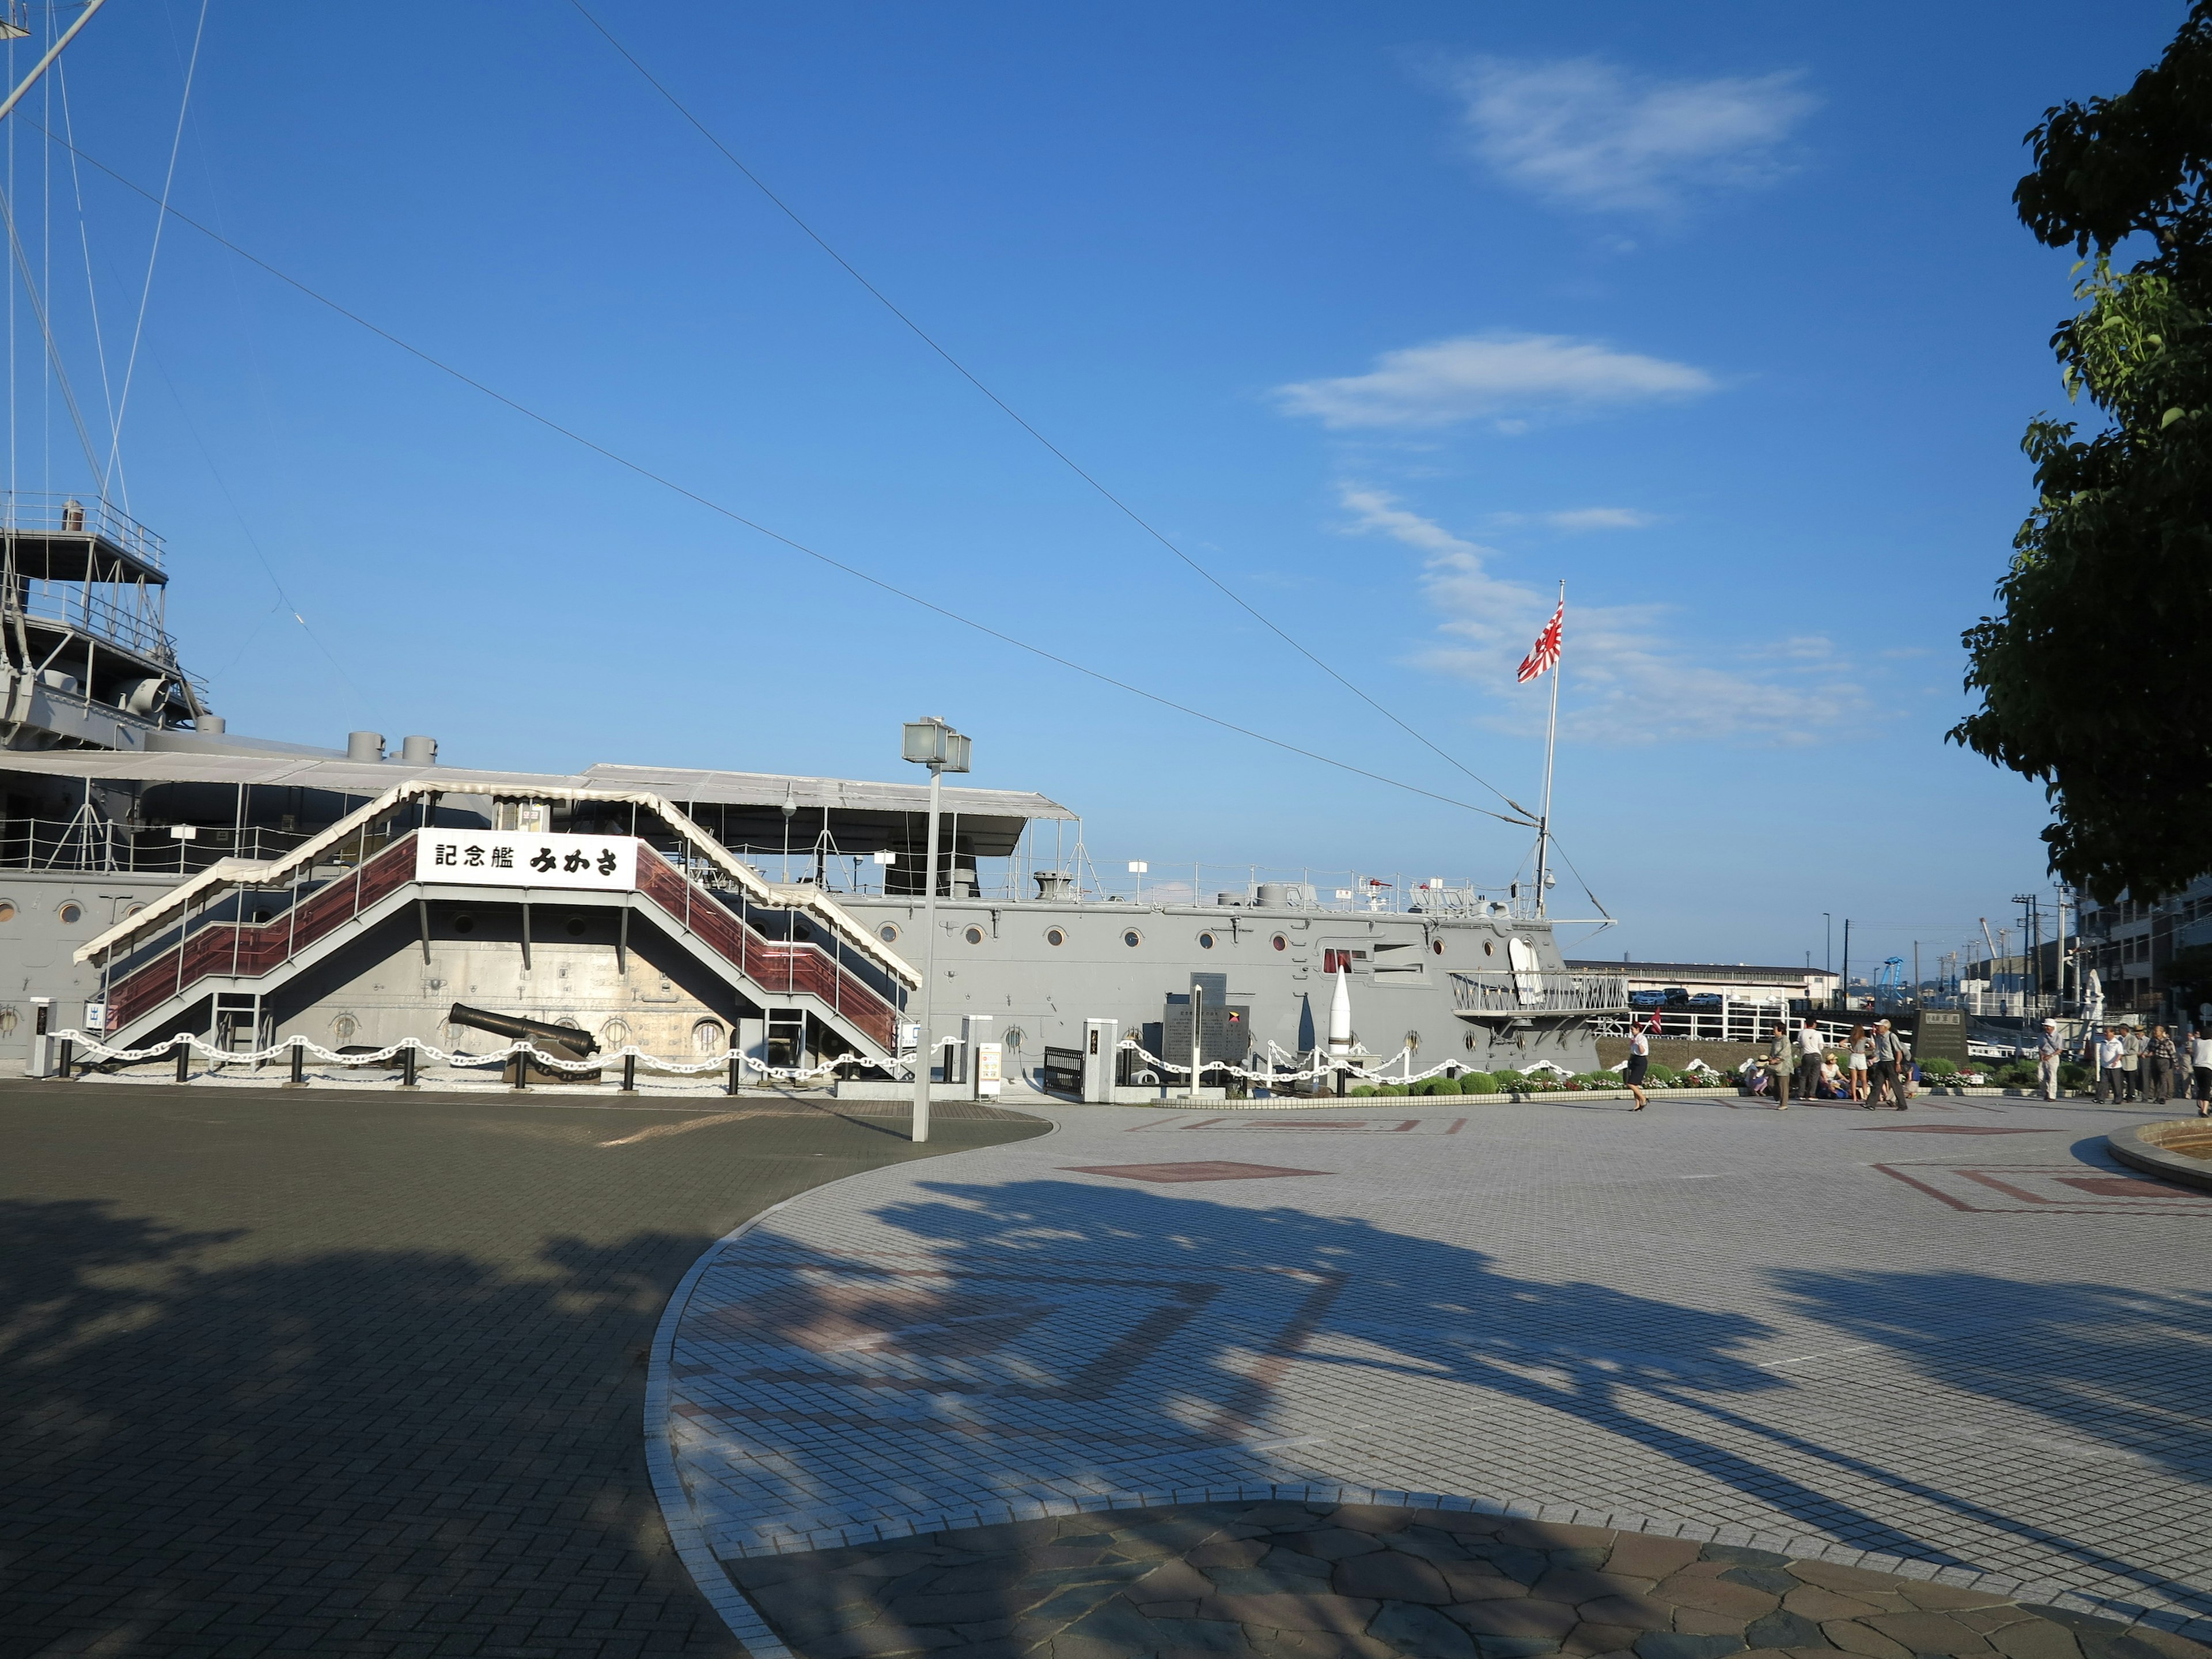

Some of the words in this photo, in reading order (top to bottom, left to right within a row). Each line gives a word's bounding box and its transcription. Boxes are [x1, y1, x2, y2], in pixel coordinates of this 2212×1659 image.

[435, 844, 514, 868] 記念艦
[530, 847, 617, 876] みかさ
